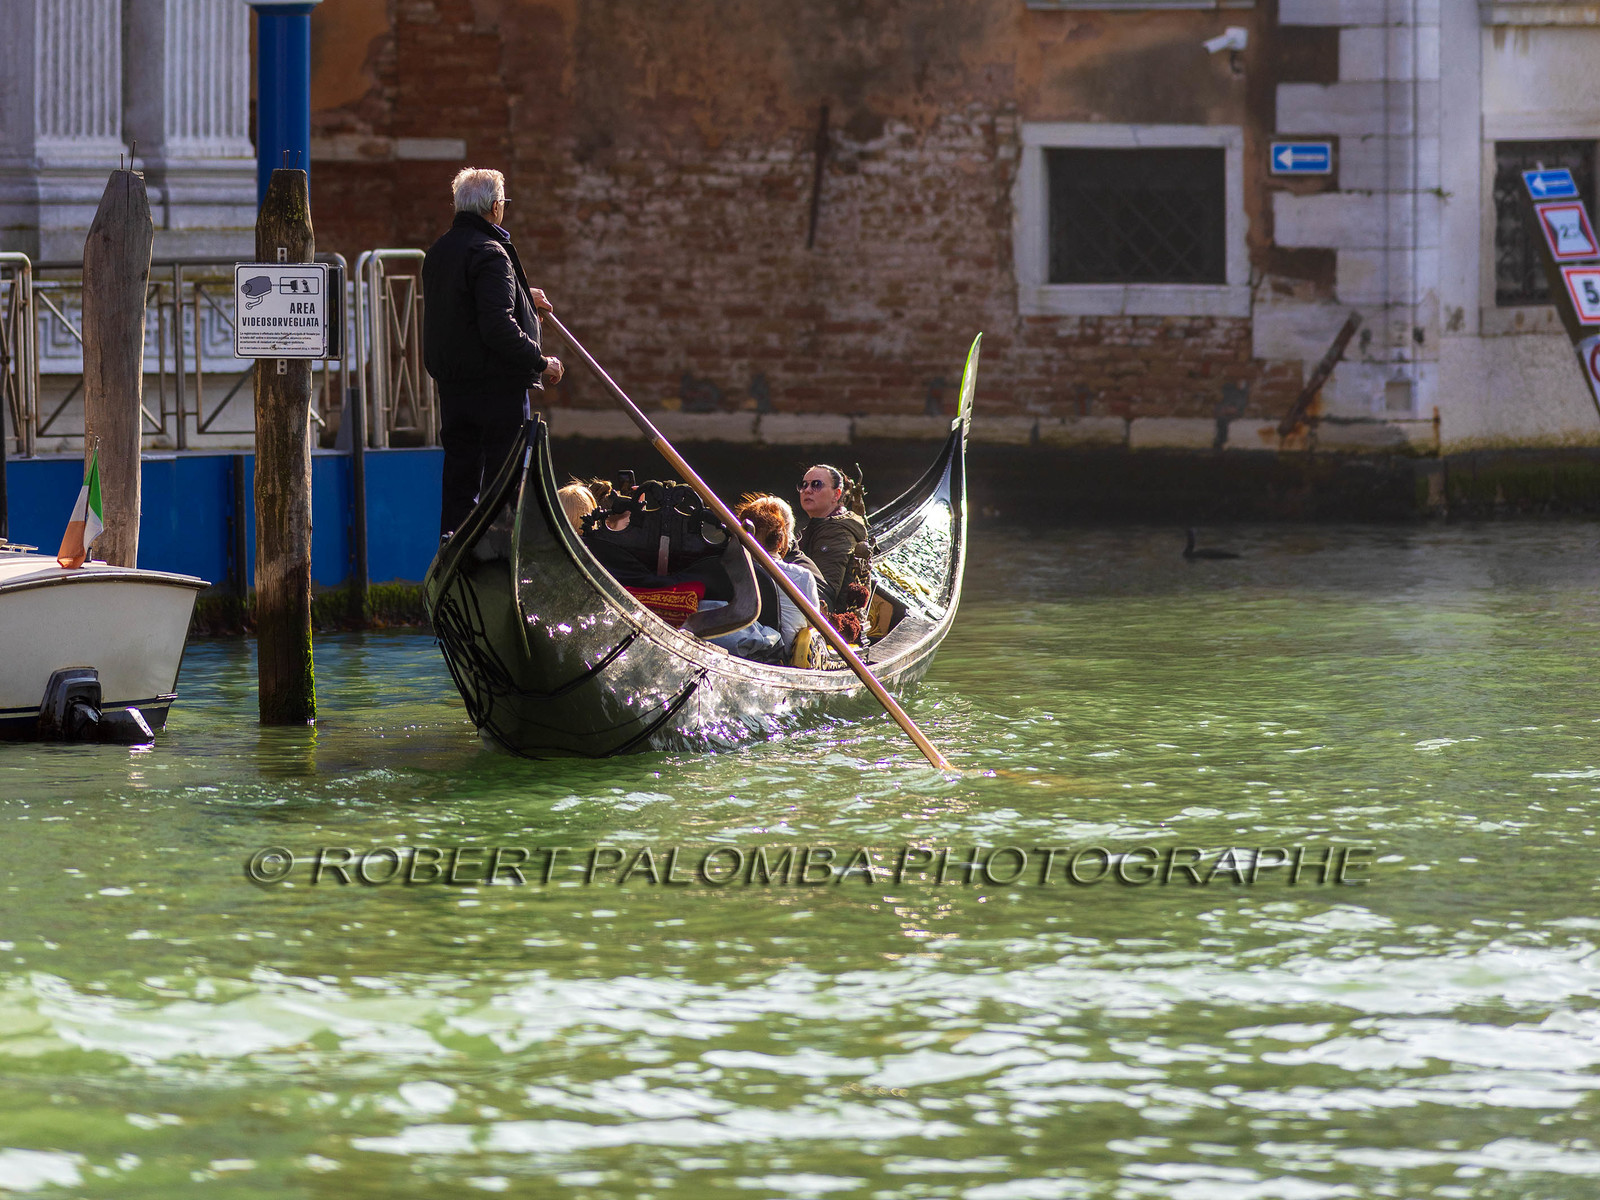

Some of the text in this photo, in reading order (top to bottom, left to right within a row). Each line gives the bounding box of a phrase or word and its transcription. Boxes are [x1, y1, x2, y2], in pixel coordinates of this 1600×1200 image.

[1583, 280, 1599, 304] 5
[289, 302, 316, 314] AREA
[241, 316, 320, 327] VIDEOSORVEGLIATA
